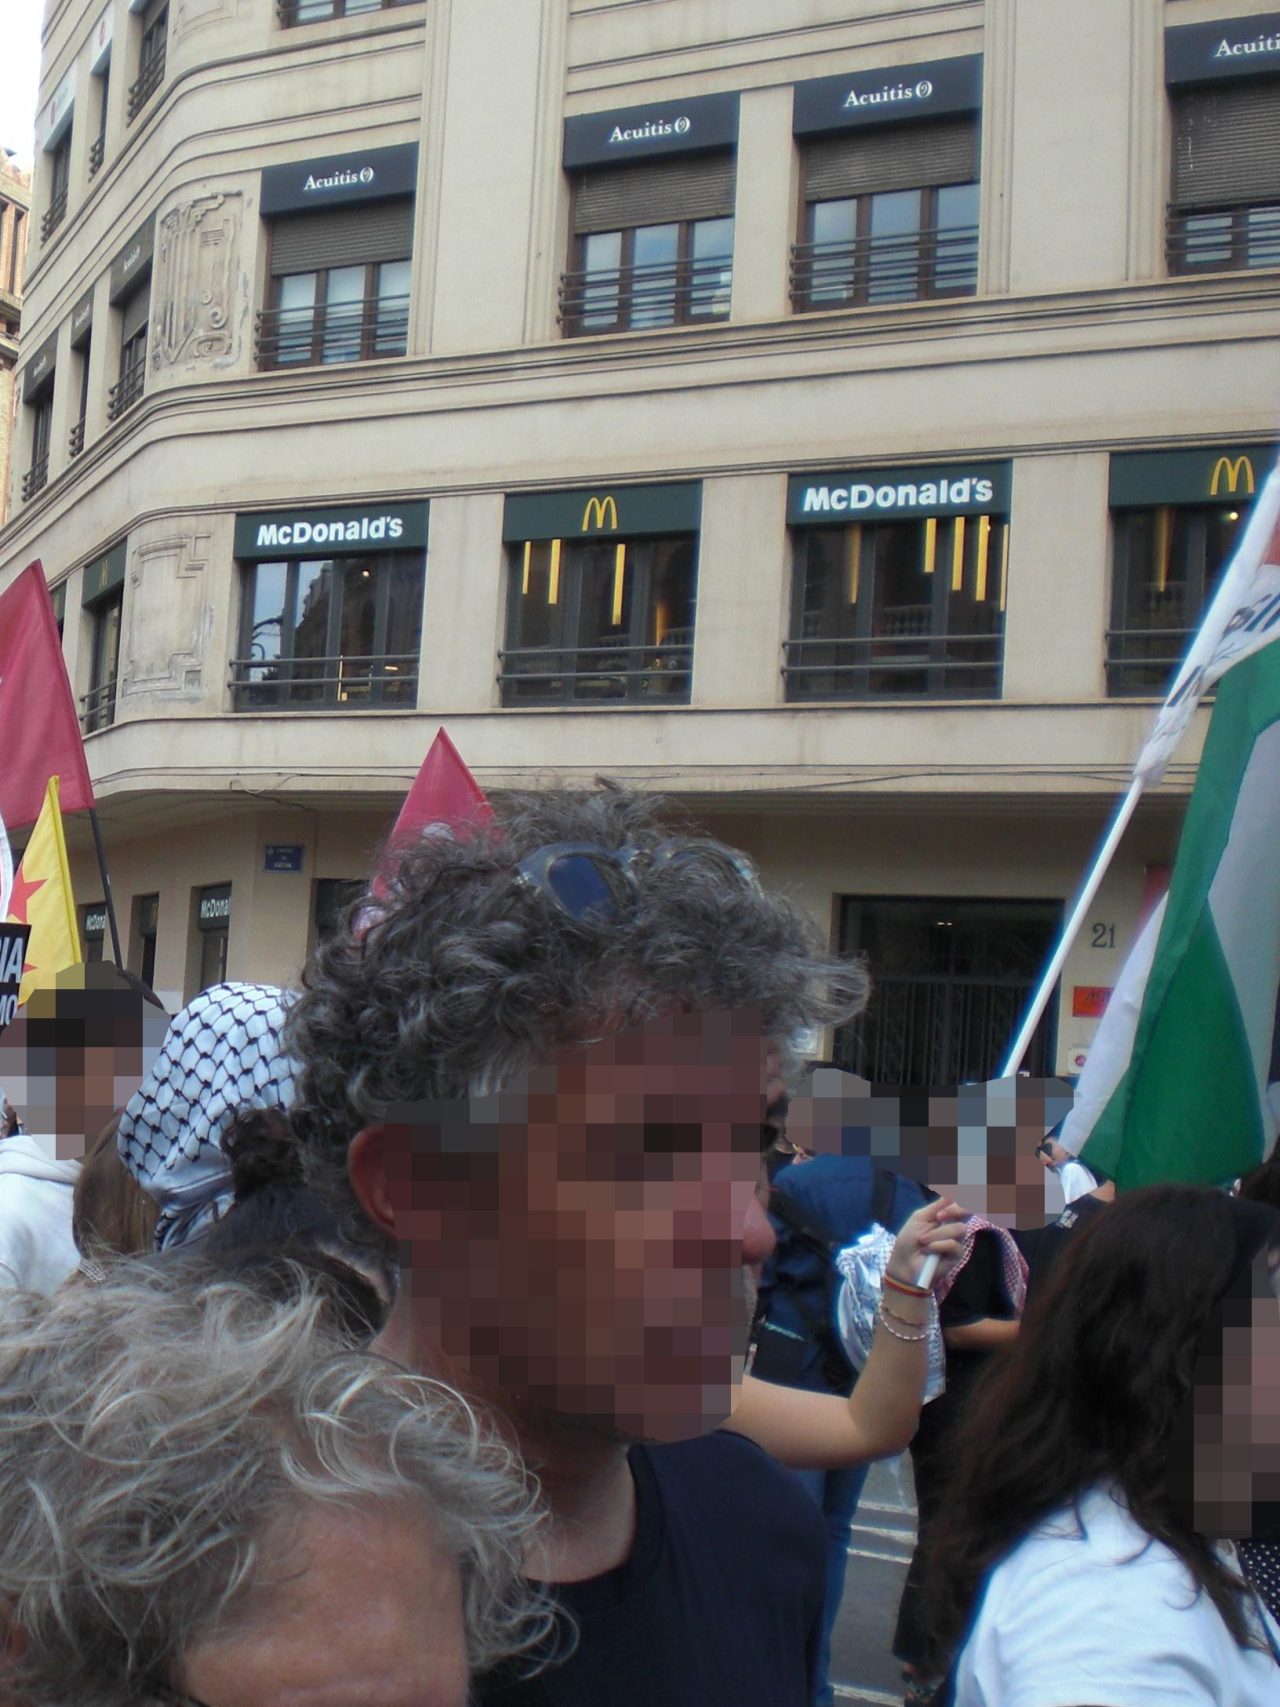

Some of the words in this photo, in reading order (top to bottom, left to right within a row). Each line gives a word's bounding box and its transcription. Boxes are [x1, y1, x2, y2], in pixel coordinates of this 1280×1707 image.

[843, 83, 913, 108] Acuitis
[609, 119, 673, 142] Acuitis
[304, 169, 358, 191] Acuitis
[803, 477, 993, 512] McDonald's
[256, 516, 404, 546] McDonald's
[1091, 922, 1116, 949] 21
